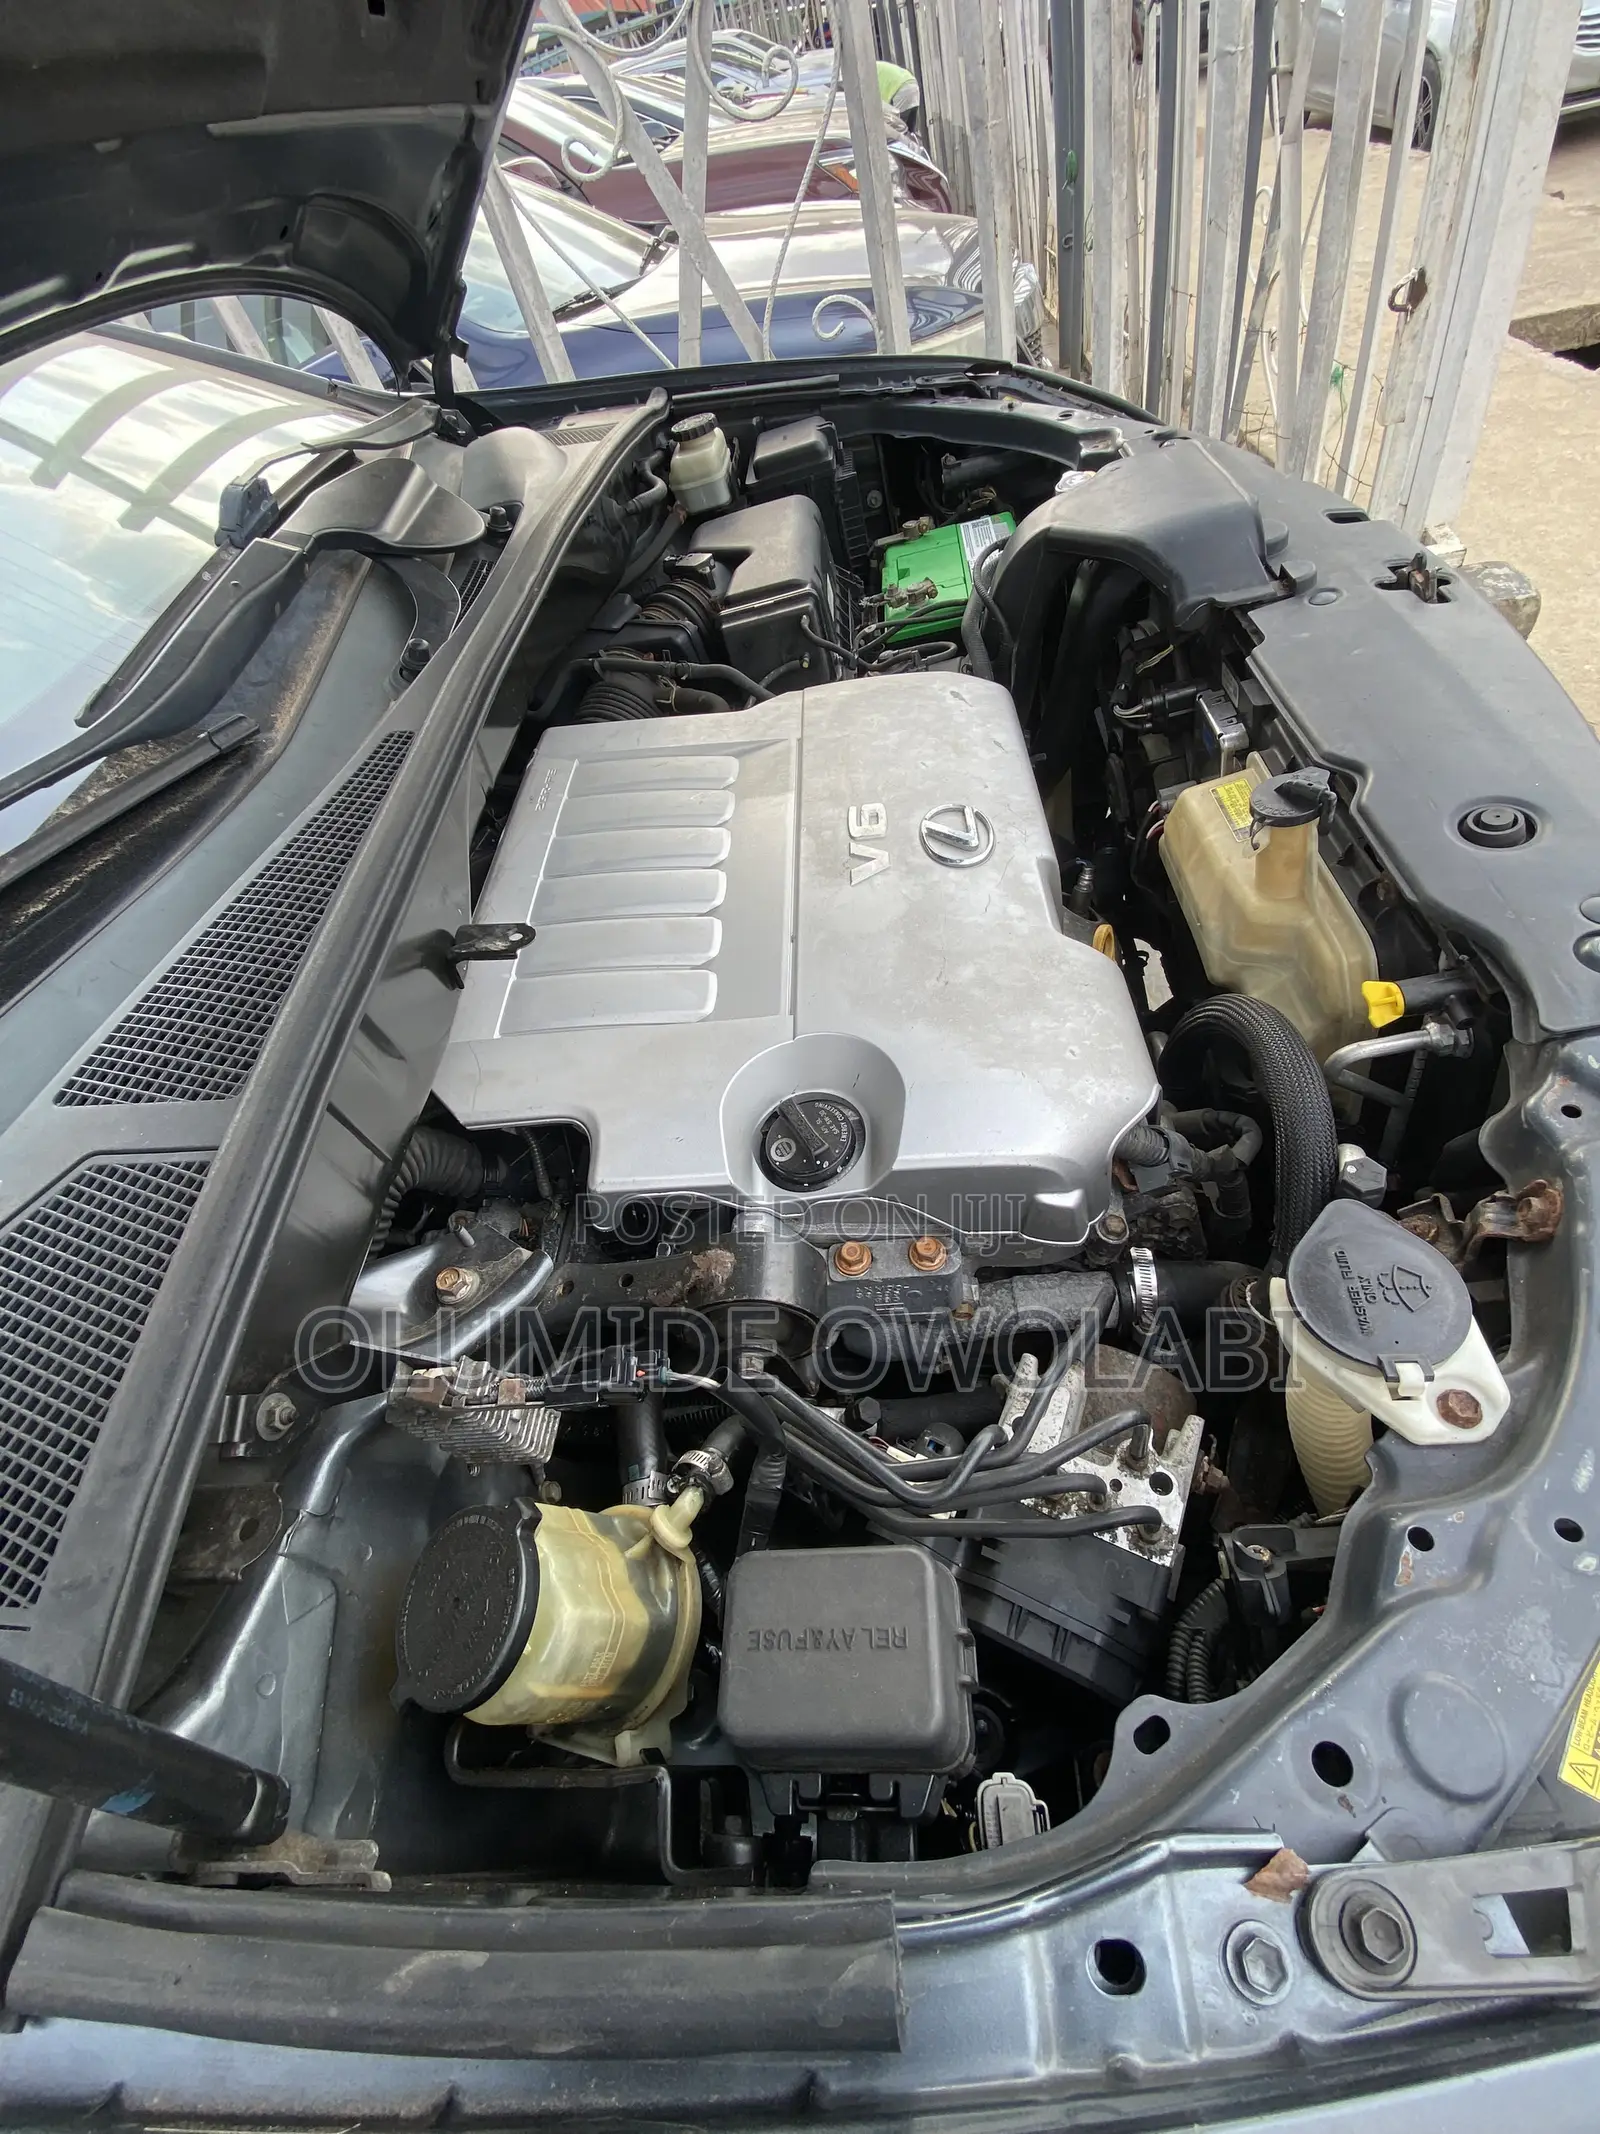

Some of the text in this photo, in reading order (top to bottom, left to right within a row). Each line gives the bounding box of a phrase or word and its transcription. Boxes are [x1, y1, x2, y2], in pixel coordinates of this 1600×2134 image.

[848, 802, 891, 887] V6
[1334, 1250, 1375, 1337] WASHER FLUID
[1574, 1709, 1589, 1746] LOW-BEAM
